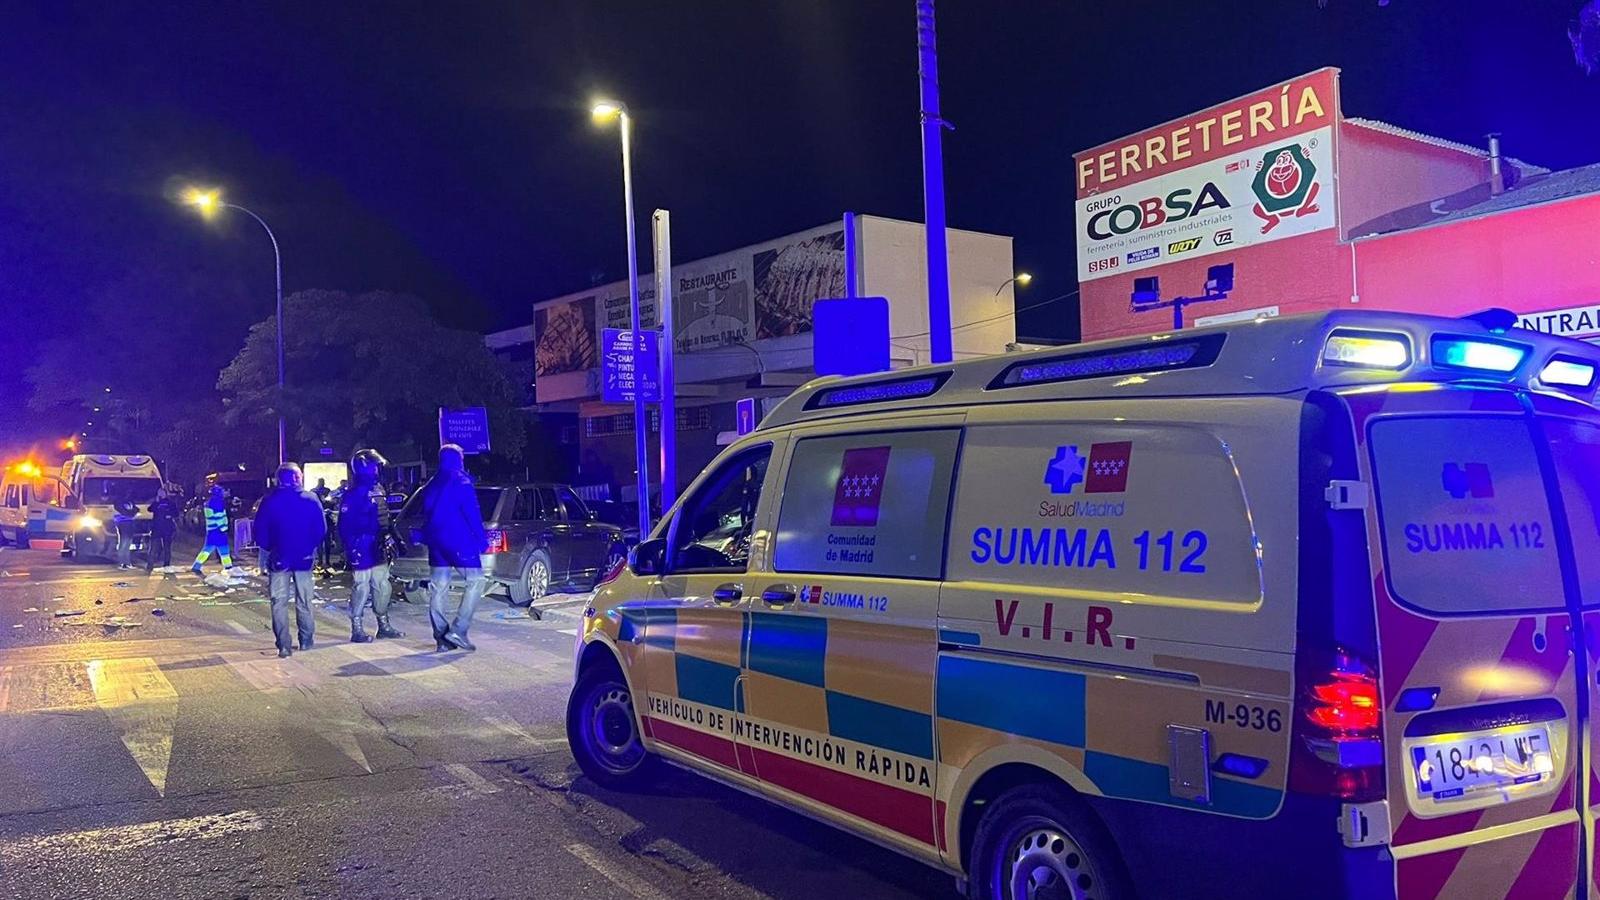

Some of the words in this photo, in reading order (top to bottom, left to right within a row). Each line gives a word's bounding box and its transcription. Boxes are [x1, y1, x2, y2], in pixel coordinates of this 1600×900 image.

[1079, 84, 1325, 189] FERRETERÍA
[1086, 195, 1121, 213] GRUPO
[1087, 181, 1232, 241] COBSA
[1087, 240, 1125, 255] ferretería
[1128, 227, 1177, 245] suministros
[1178, 212, 1233, 232] industriales
[680, 268, 737, 292] RESTAURANTE
[618, 354, 635, 363] CHAP
[1039, 501, 1125, 517] SaludMadrid
[827, 534, 876, 546] Comunidad
[970, 527, 1116, 569] SUMMA
[1133, 529, 1208, 573] 112
[1404, 522, 1504, 554] SUMMA
[1509, 521, 1545, 549] 112
[826, 549, 837, 561] de
[840, 550, 874, 563] Madrid
[822, 591, 865, 609] SUMMA
[868, 596, 889, 612] 112
[994, 599, 1136, 650] V.I.R.
[1205, 699, 1282, 732] M-936
[648, 696, 703, 724] VEHÍCULO
[709, 712, 724, 730] DE
[730, 718, 846, 766] INTERVENCIÓN
[856, 749, 931, 788] RÁPIDA
